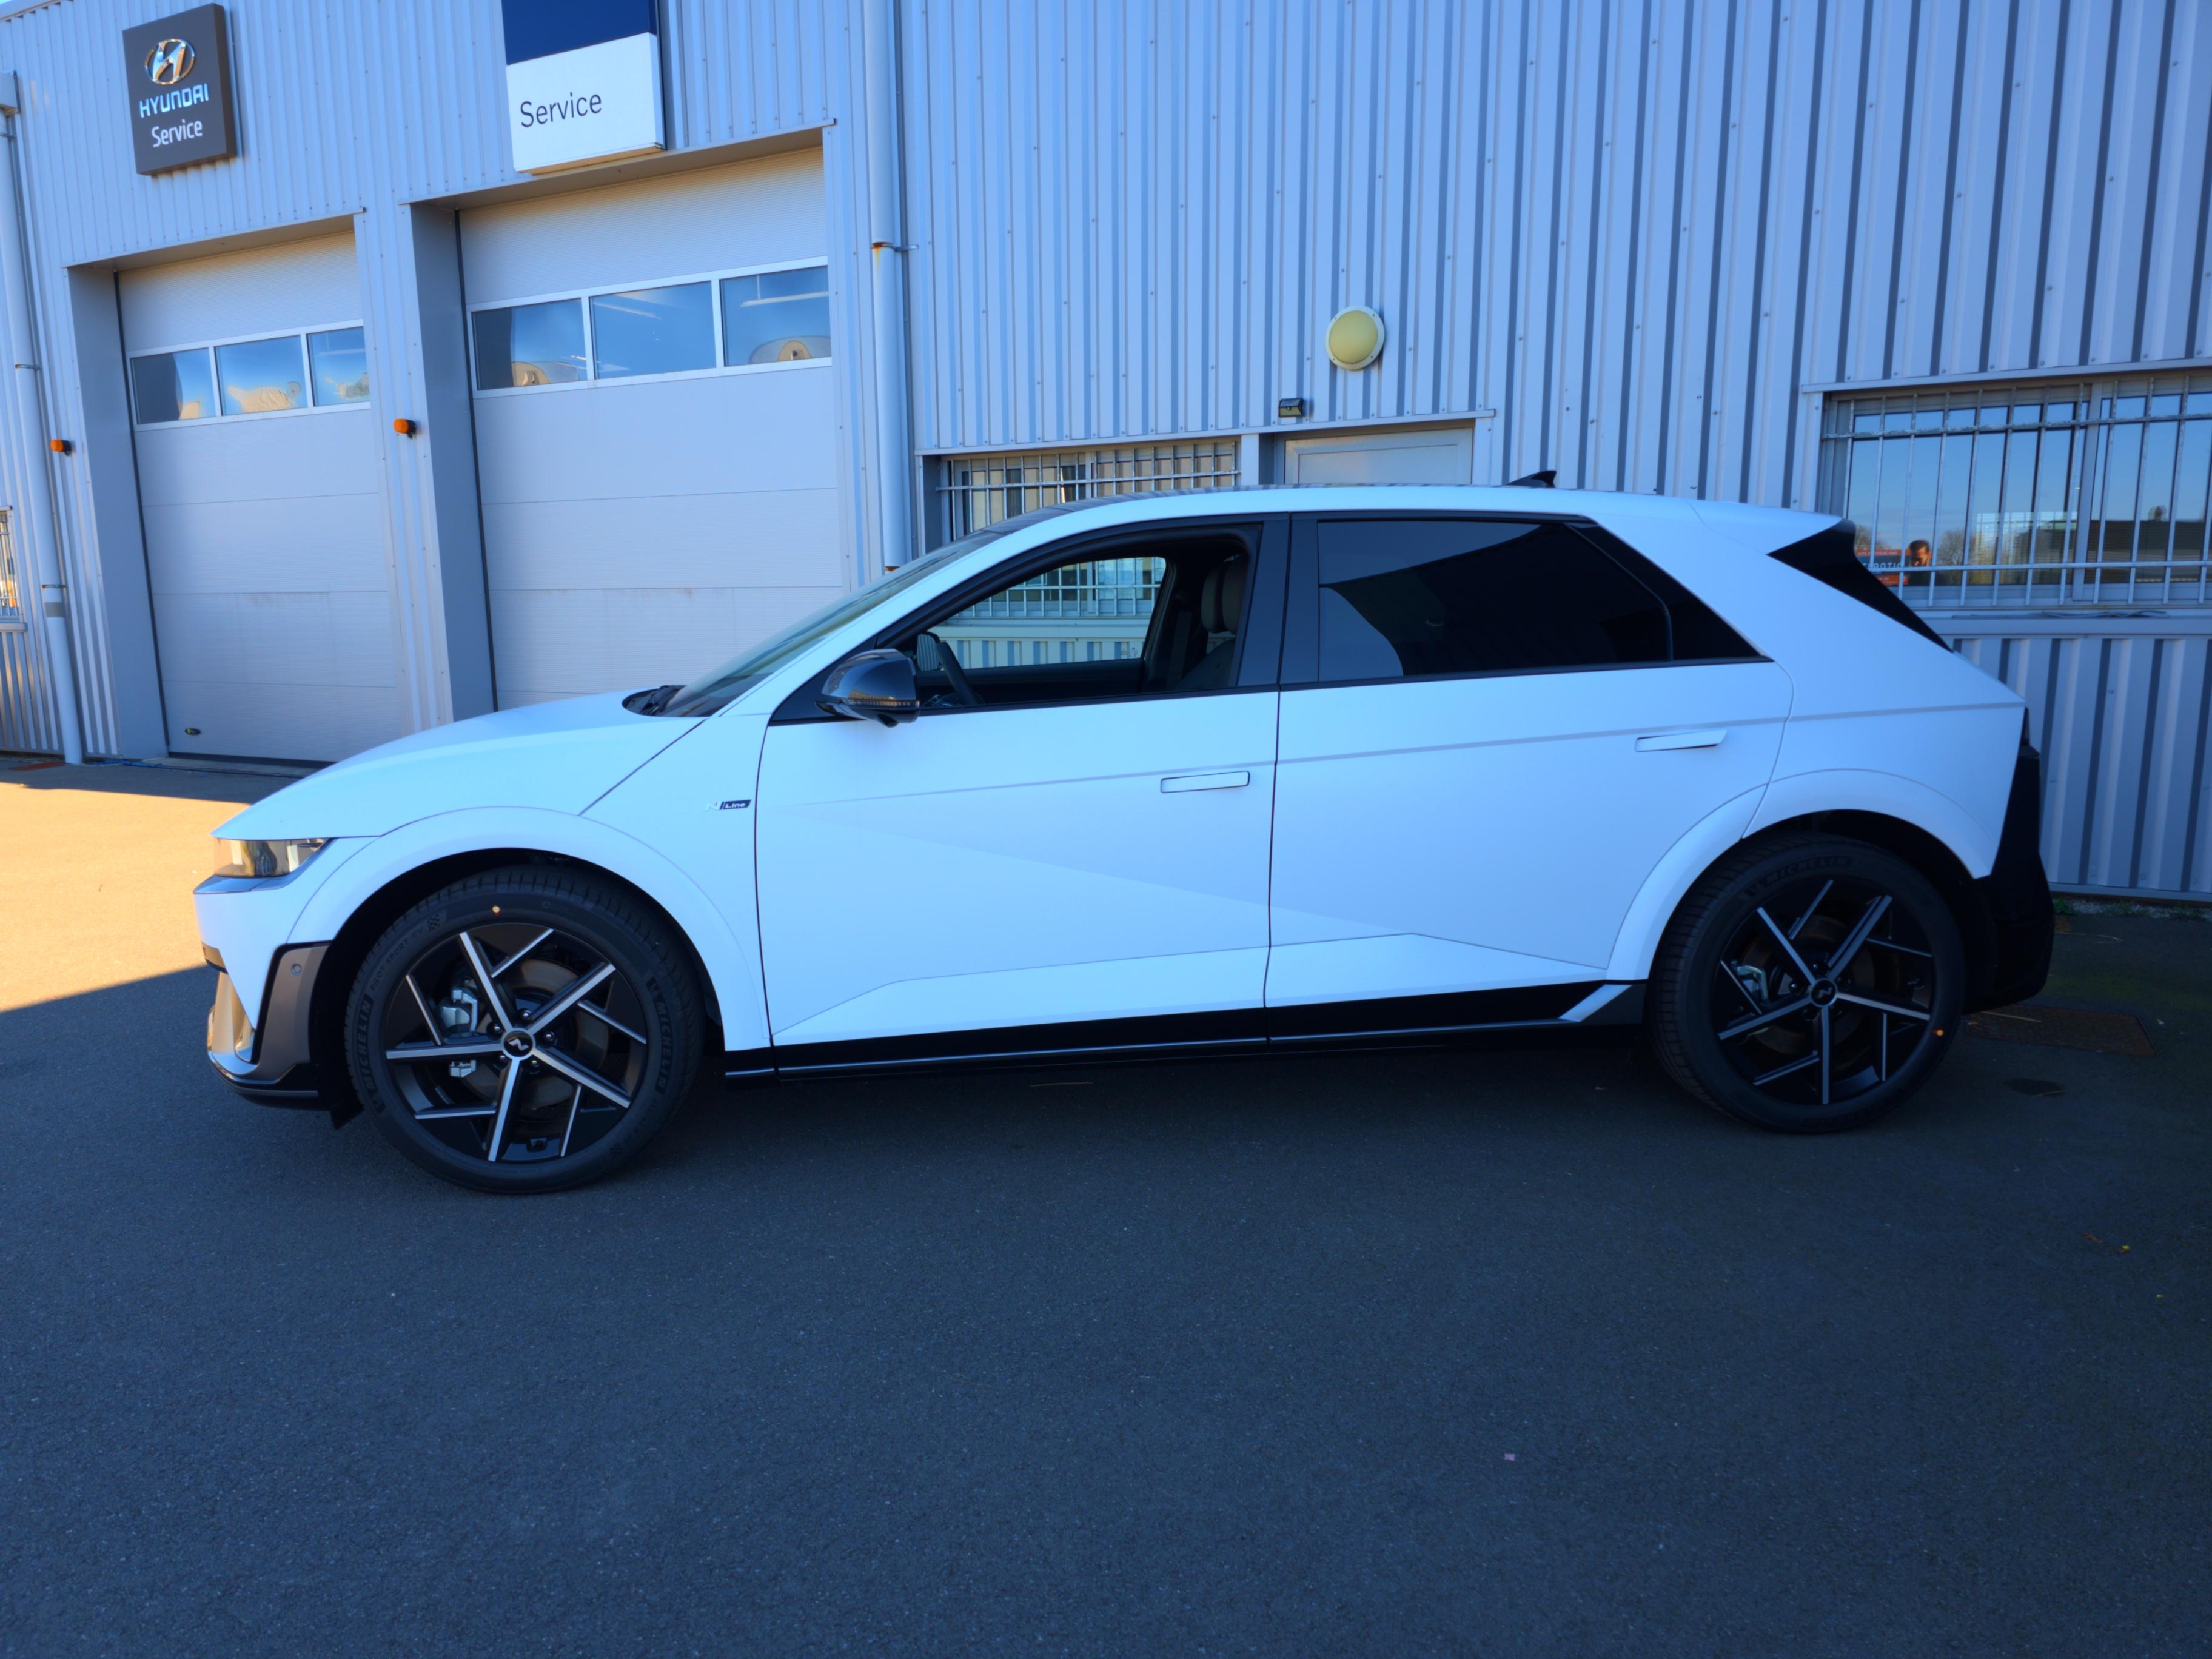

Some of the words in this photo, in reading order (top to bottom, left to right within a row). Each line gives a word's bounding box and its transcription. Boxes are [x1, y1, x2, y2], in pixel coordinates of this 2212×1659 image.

[139, 83, 209, 118] HYUNDAI
[520, 92, 602, 128] Service
[152, 119, 203, 147] Service
[357, 997, 377, 1091] MICHELIN
[370, 970, 384, 991] PILOT
[386, 939, 409, 963] SPORT
[656, 1001, 672, 1088] MICHELIN
